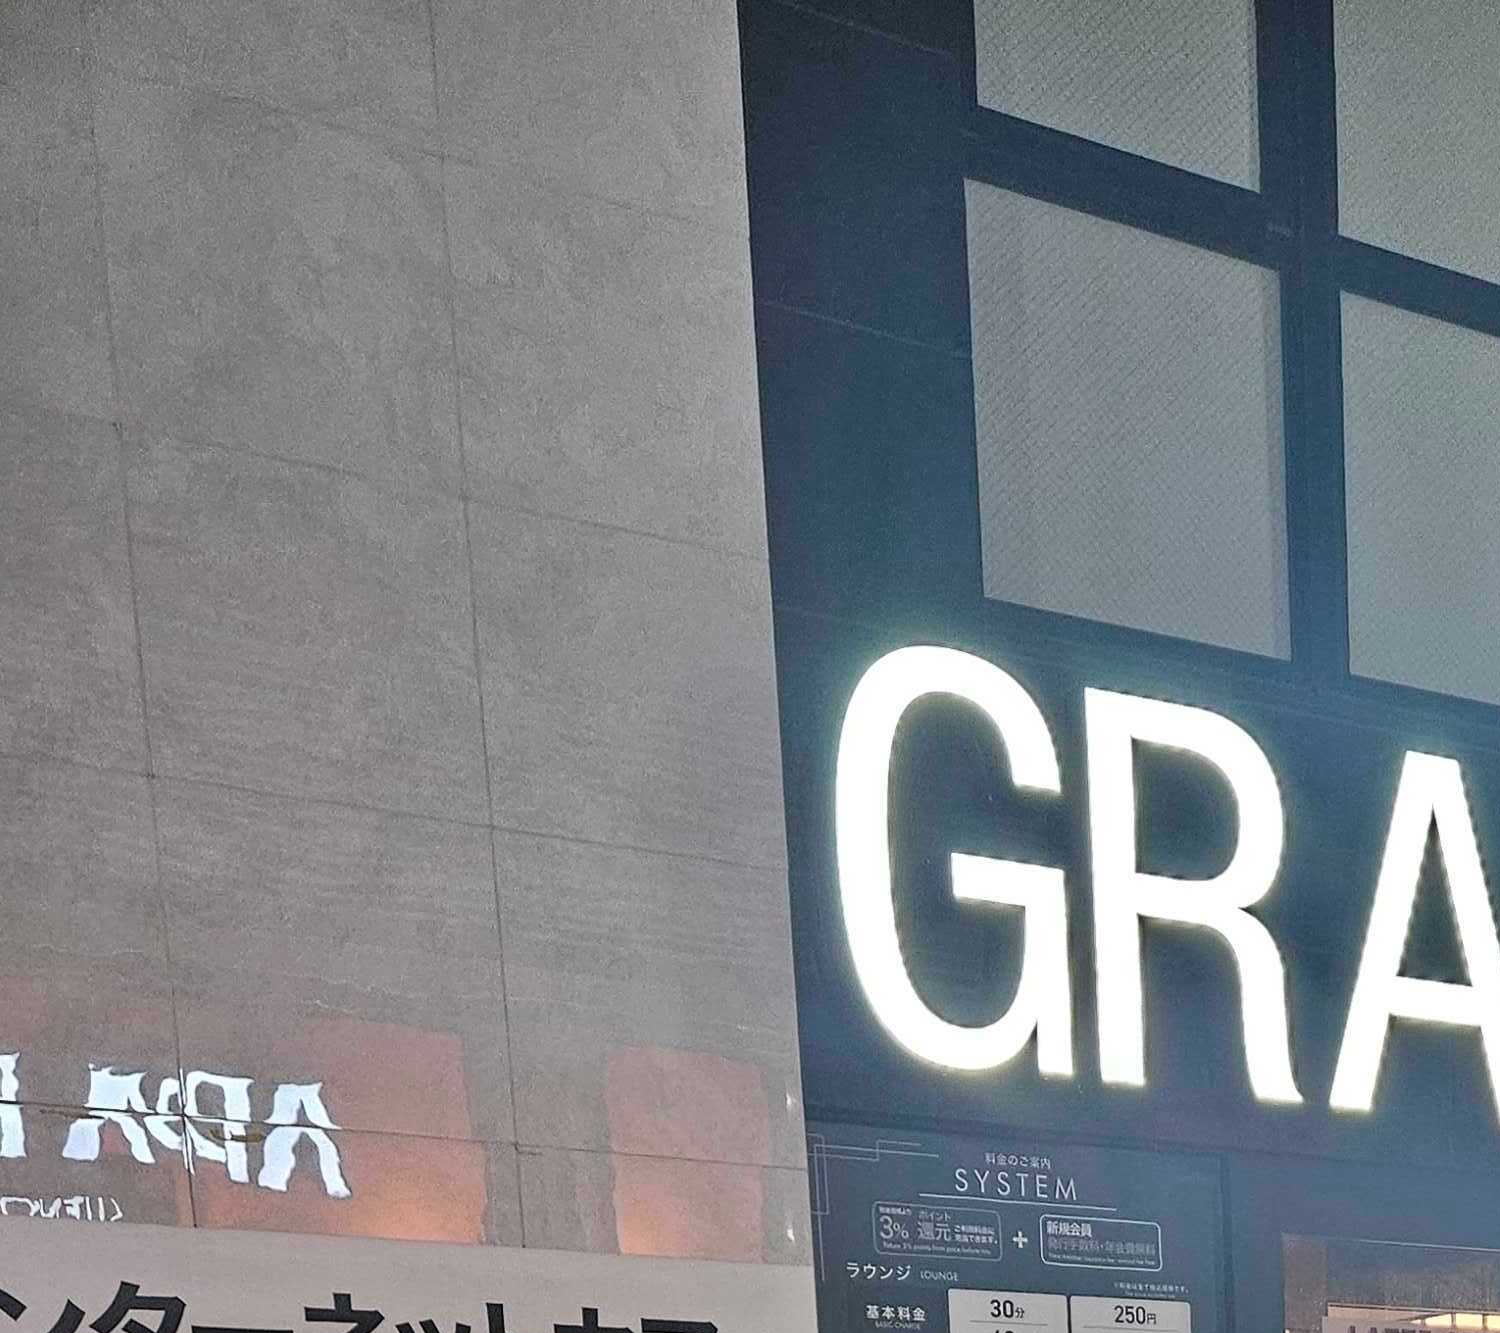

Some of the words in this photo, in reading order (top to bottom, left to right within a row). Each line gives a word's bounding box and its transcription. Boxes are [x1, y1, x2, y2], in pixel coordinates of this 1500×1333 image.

[955, 1168, 1077, 1200] SYSTEM
[879, 1215, 910, 1240] 3%
[1047, 1220, 1092, 1238] 新規会員
[846, 1261, 912, 1281] ラウンジ
[865, 1304, 927, 1322] 基本料金
[990, 1300, 1025, 1318] 30分
[1114, 1306, 1157, 1325] 250円
